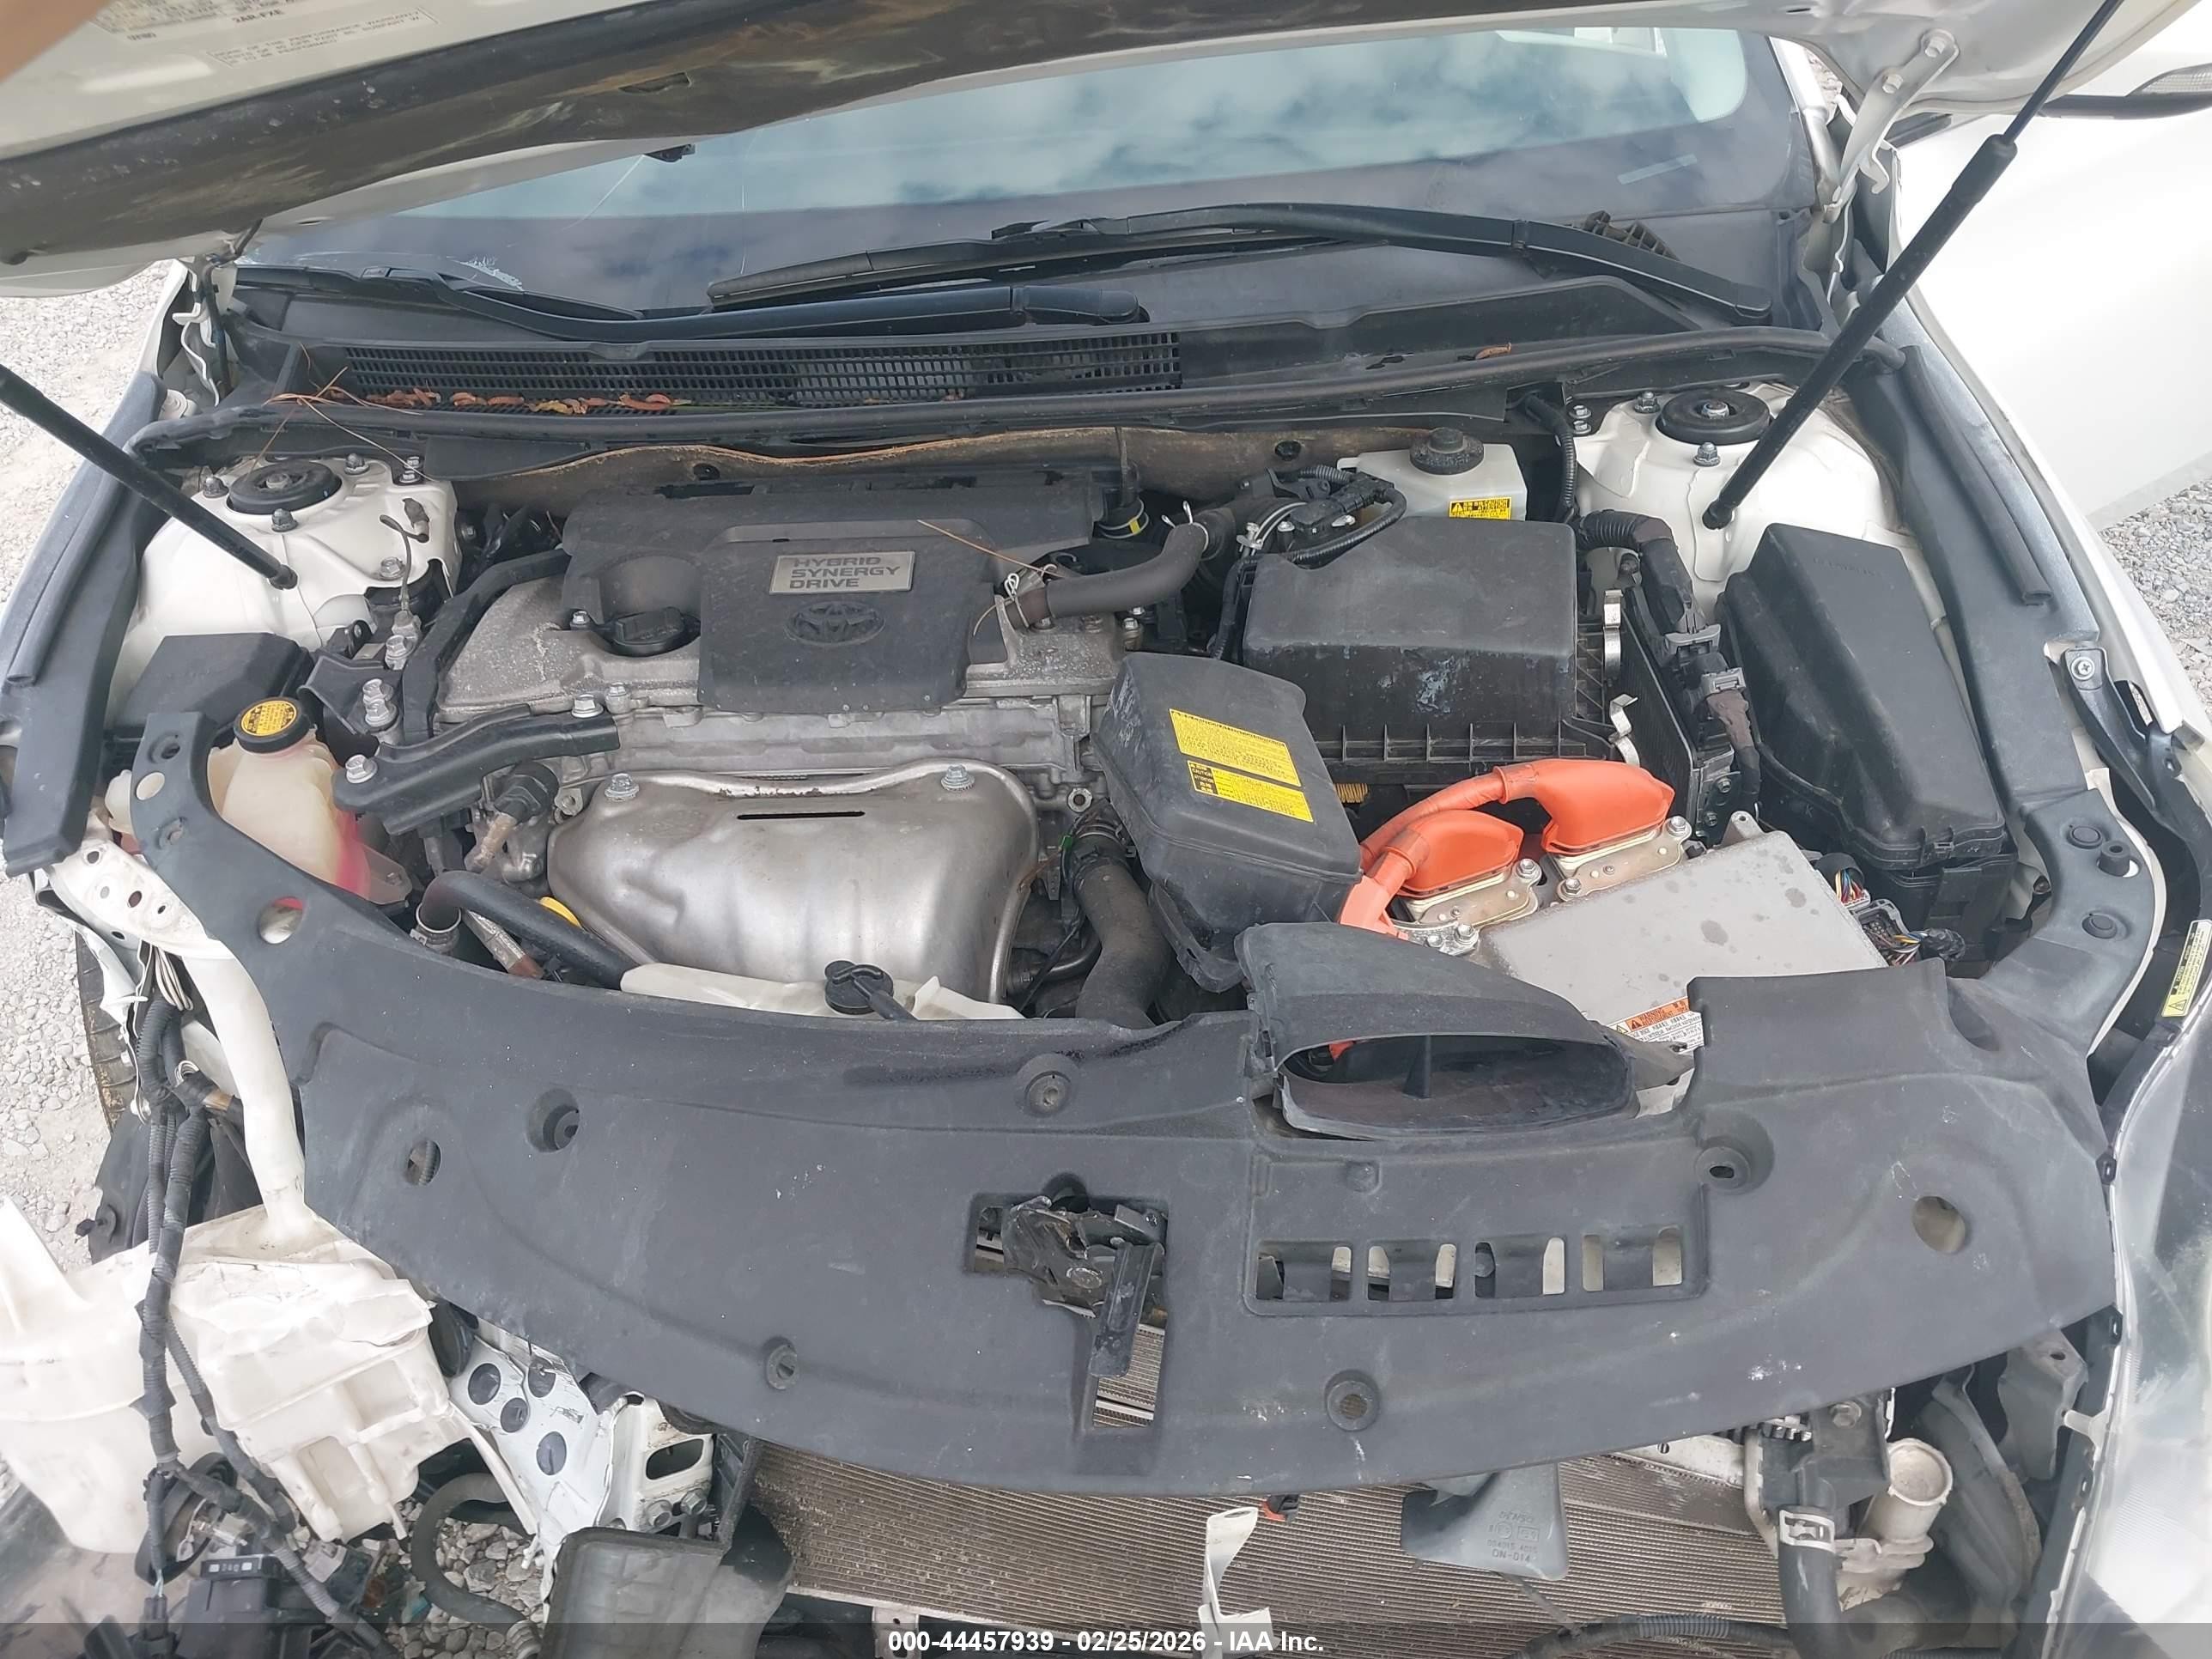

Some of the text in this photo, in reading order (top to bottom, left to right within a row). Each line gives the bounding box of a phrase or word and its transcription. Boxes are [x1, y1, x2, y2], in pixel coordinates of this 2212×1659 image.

[793, 556, 882, 568] HYBRID
[791, 567, 901, 578] SYNERGY
[789, 578, 860, 589] DRIVE
